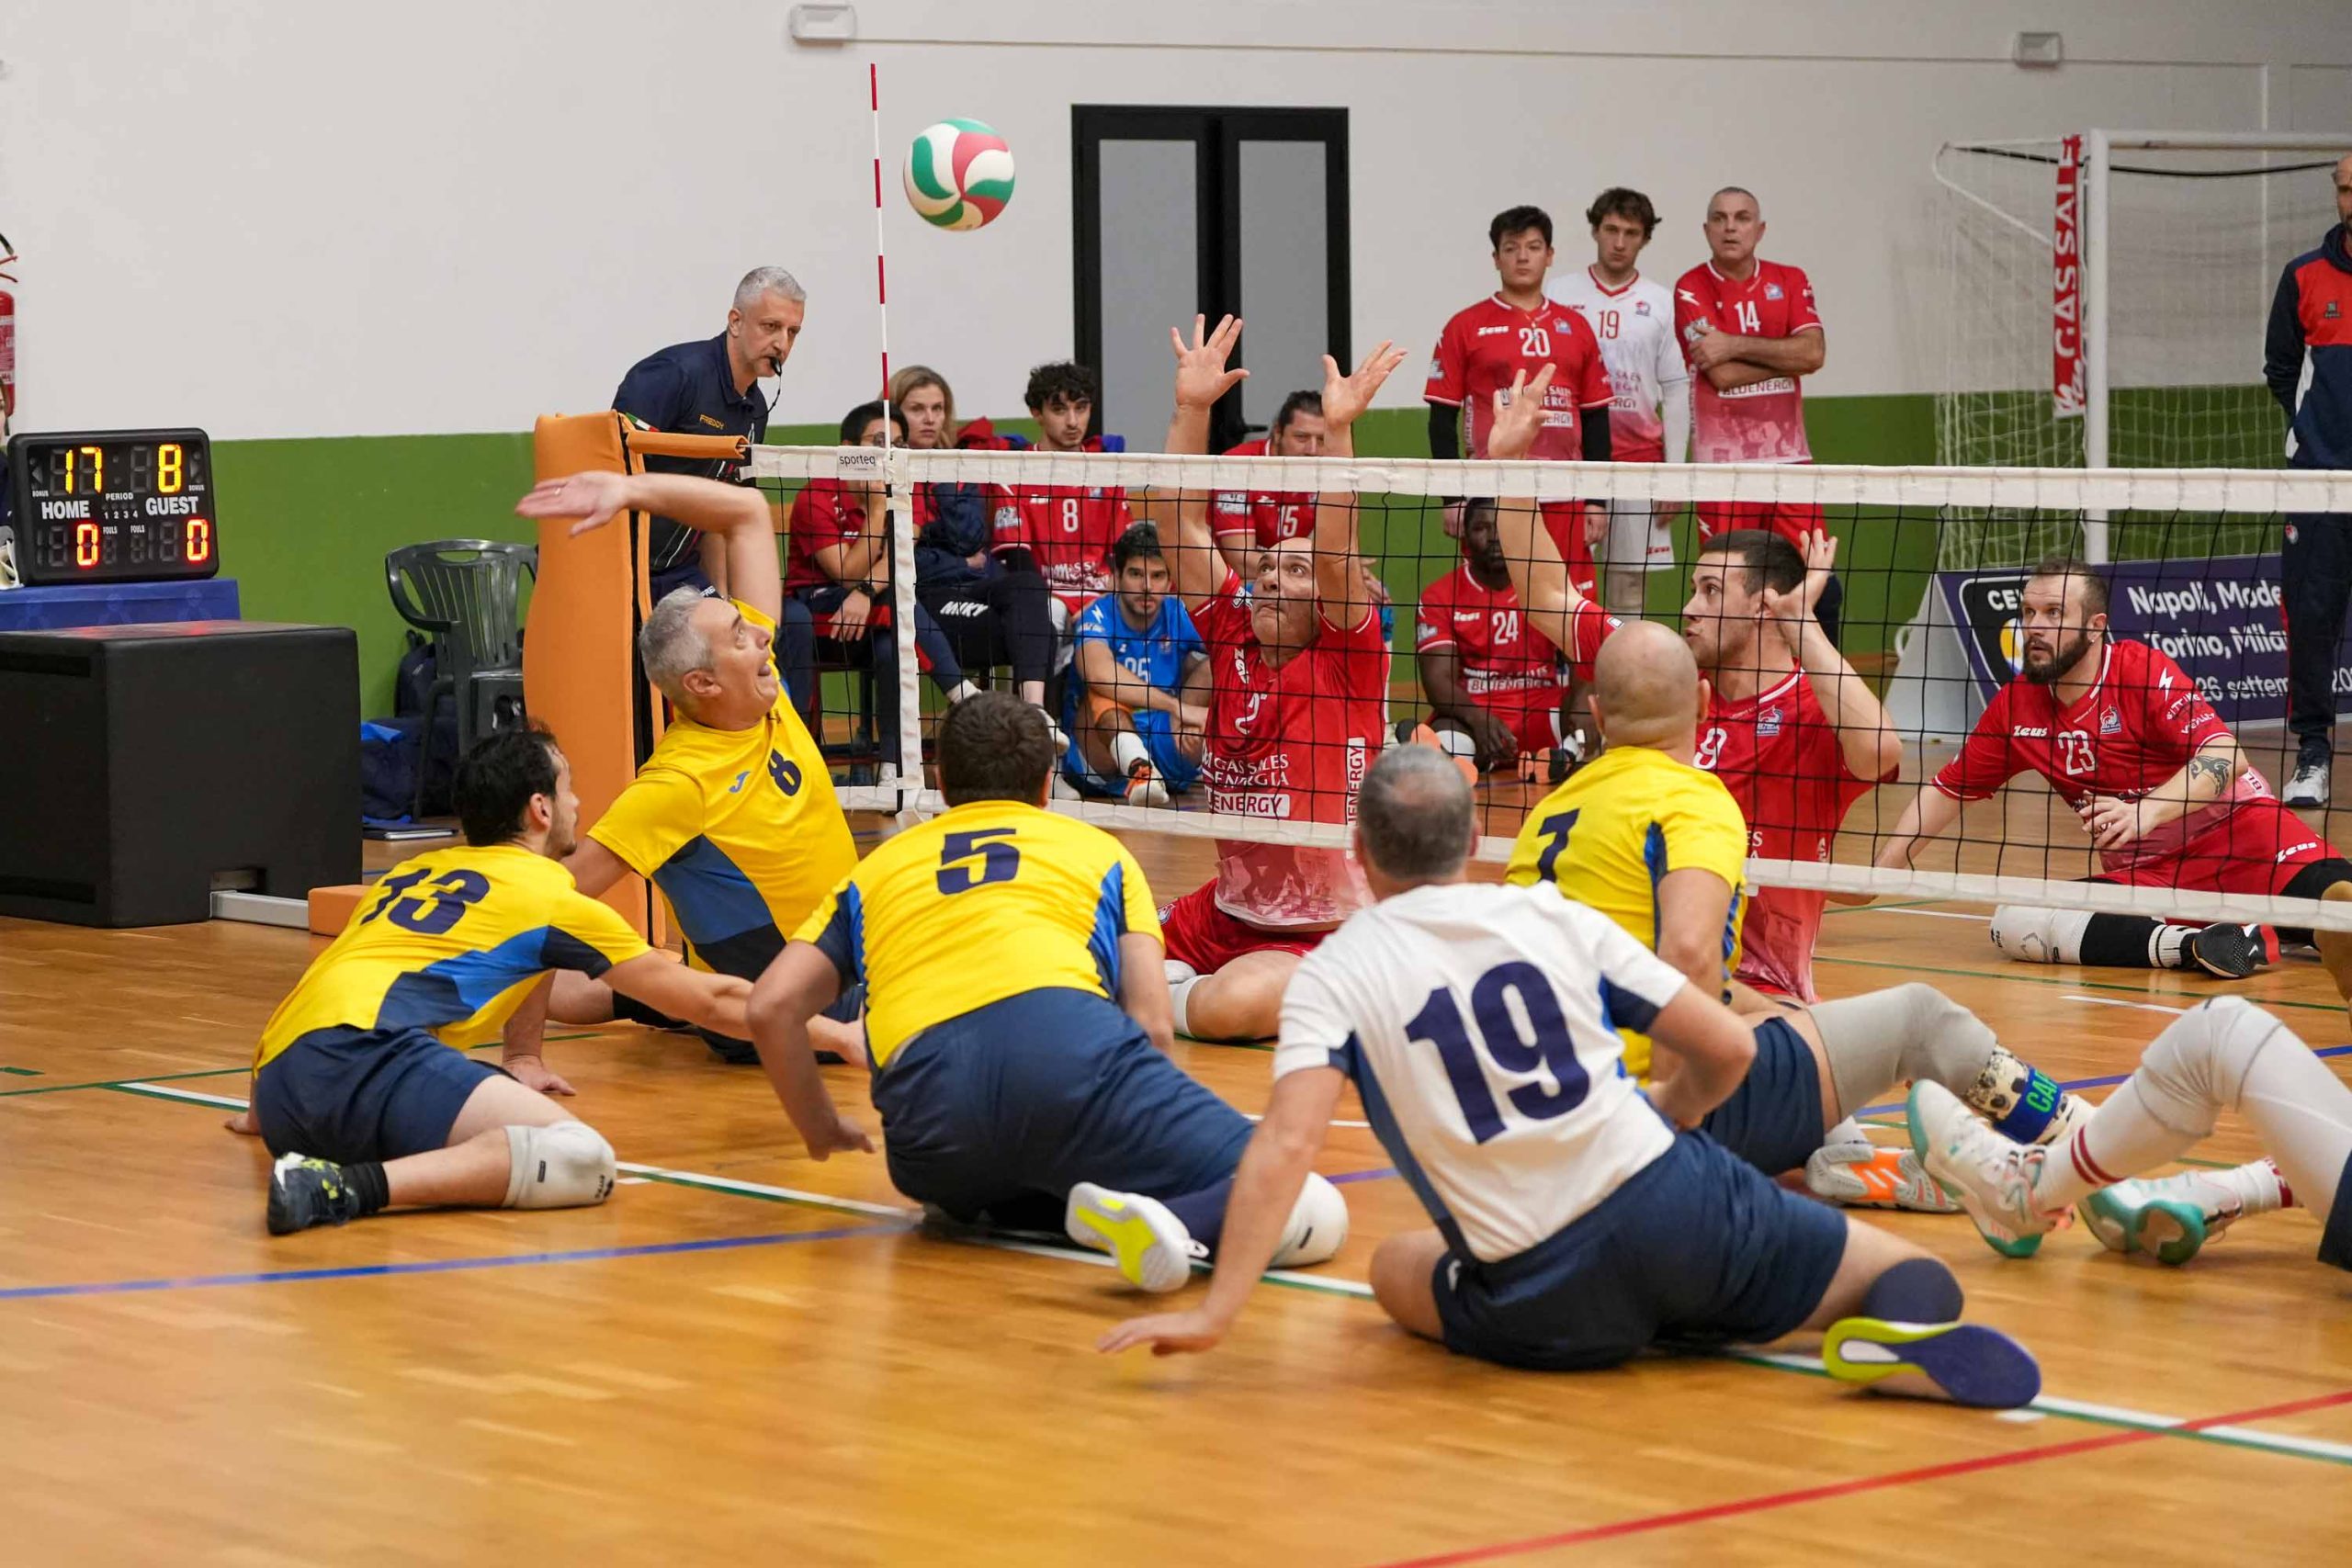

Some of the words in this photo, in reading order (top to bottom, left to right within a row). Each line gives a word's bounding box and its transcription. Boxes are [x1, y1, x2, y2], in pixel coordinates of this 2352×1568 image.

[1599, 310, 1620, 340] 19
[1735, 301, 1761, 333] 14
[1519, 327, 1551, 356] 20
[699, 413, 725, 431] FREDDY
[66, 446, 102, 494] 17
[158, 445, 182, 492] 8
[839, 455, 876, 467] sporteq
[41, 501, 91, 519] HOME
[146, 497, 198, 515] GUEST
[124, 511, 129, 519] 3
[1063, 498, 1079, 533] 8
[1277, 505, 1299, 537] 15
[77, 524, 98, 566] 0
[187, 519, 209, 561] 0
[2127, 581, 2217, 621] Napoli,
[1493, 611, 1519, 645] 24
[2143, 628, 2232, 660] Torino,
[2230, 623, 2288, 654] Mila
[2195, 676, 2223, 702] 26
[2013, 726, 2048, 737] Zeus
[1214, 757, 1245, 773] GAS
[1692, 728, 1727, 770] 9
[2057, 730, 2096, 776] 23
[766, 748, 802, 796] 8
[936, 829, 1020, 896] 5
[1537, 808, 1580, 883] 7
[2276, 841, 2318, 864] Zeus
[360, 868, 491, 935] 13
[1405, 961, 1591, 1145] 19
